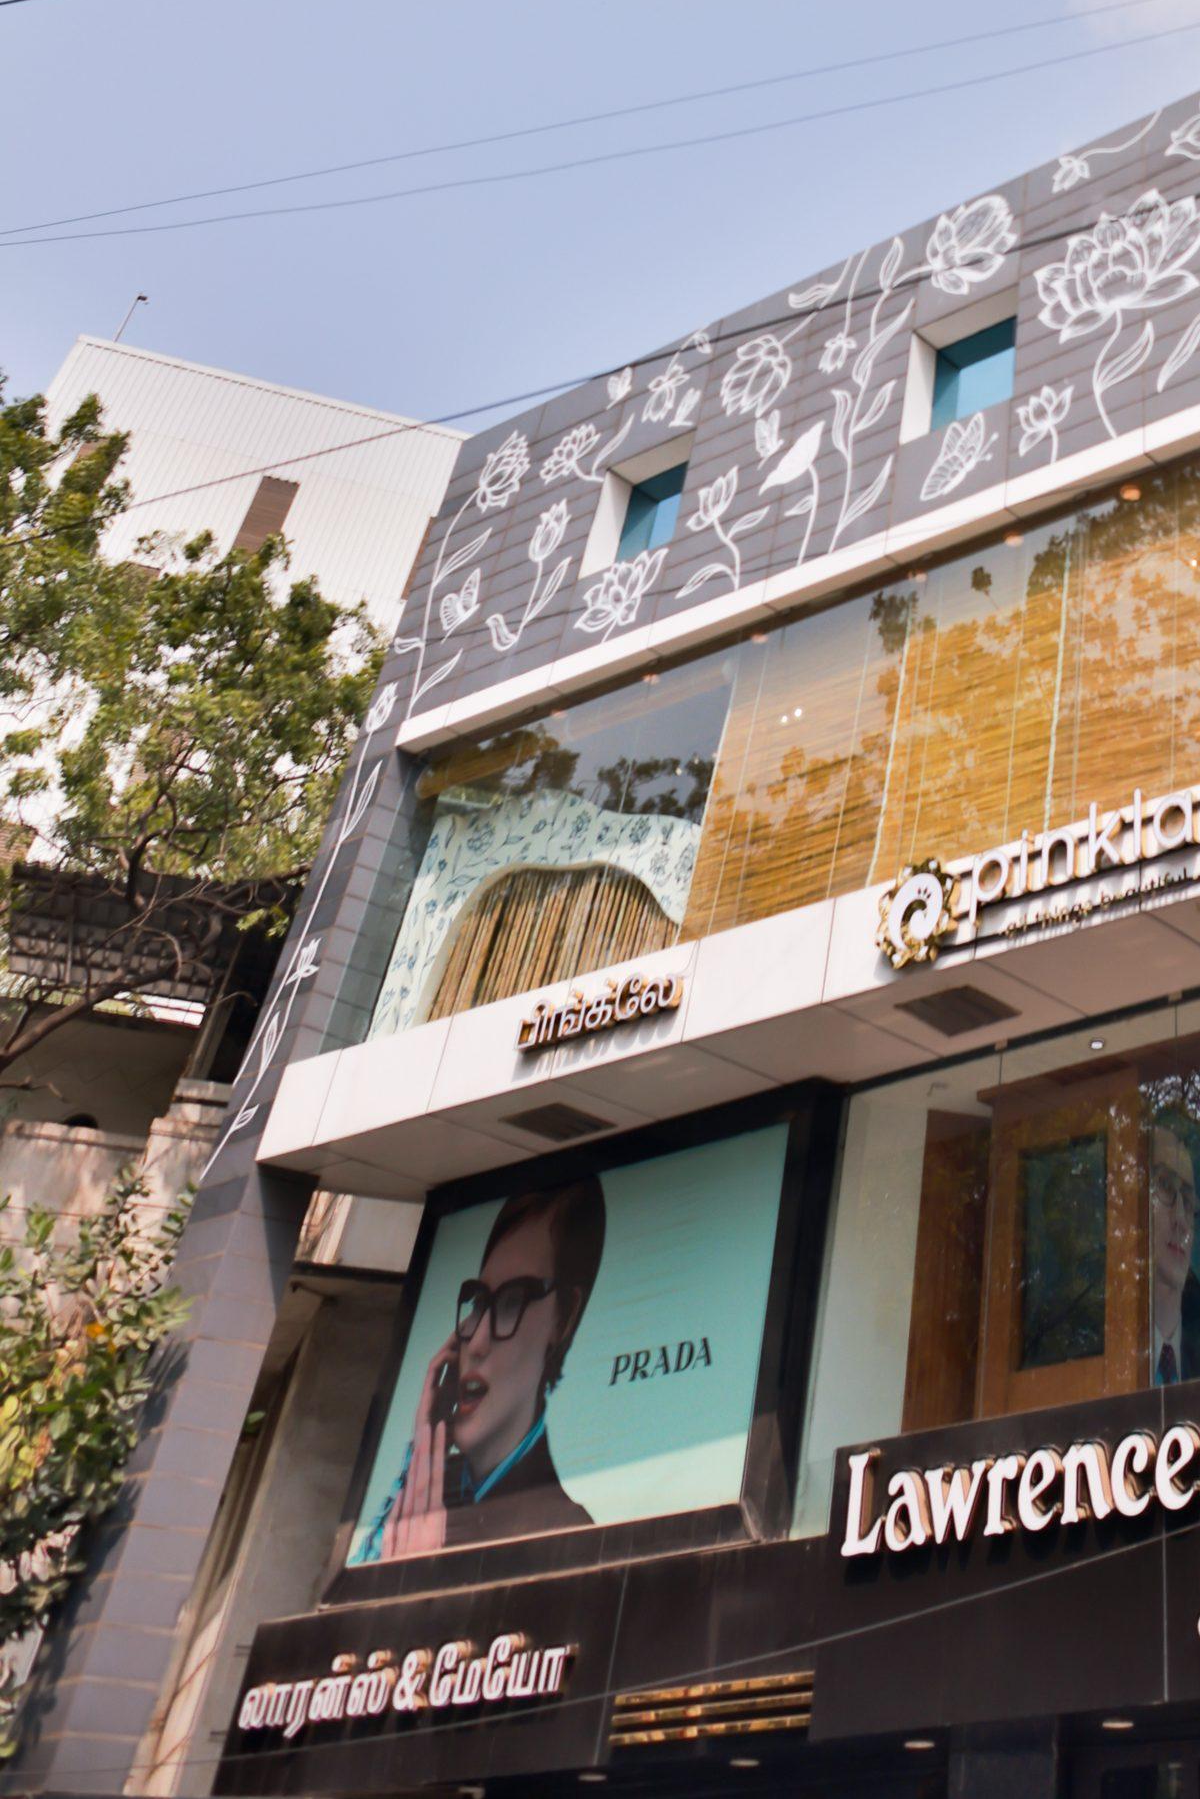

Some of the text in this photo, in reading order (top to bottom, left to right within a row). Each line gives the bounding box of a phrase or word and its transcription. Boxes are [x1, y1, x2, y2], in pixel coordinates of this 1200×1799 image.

[608, 1336, 713, 1387] PRADA
[238, 1632, 574, 1739] லாரன்ஸ் & மேயோ
